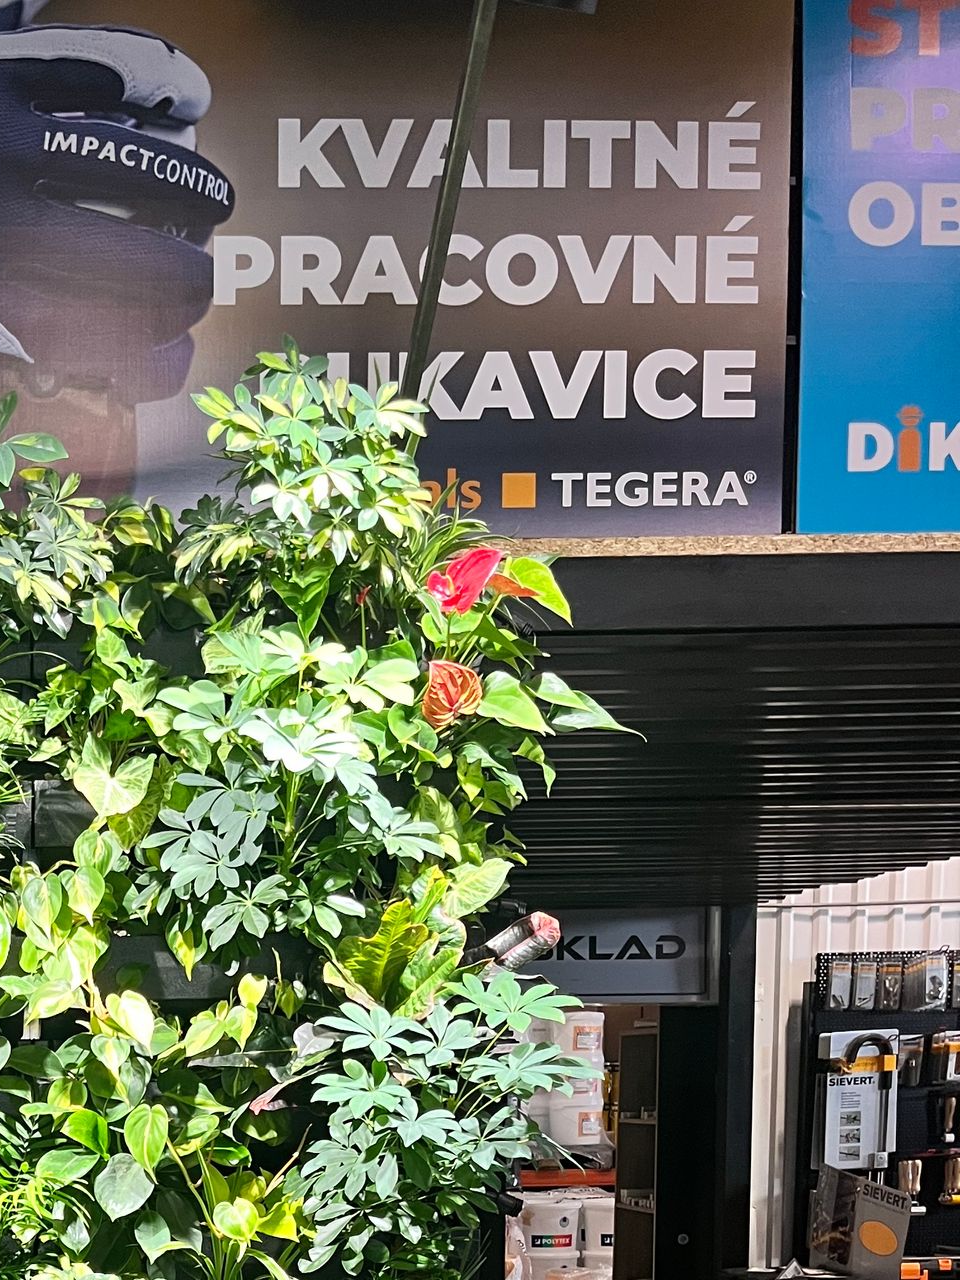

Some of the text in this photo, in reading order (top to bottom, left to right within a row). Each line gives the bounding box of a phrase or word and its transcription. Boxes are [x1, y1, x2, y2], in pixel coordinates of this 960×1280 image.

[43, 131, 229, 206] IMPACTCONTROL
[277, 101, 761, 190] KVALITNÉ
[213, 216, 759, 306] PRACOVNÉ
[531, 935, 686, 961] KLAD
[828, 1076, 874, 1087] SIEVERT
[862, 1183, 908, 1210] SIEVERT
